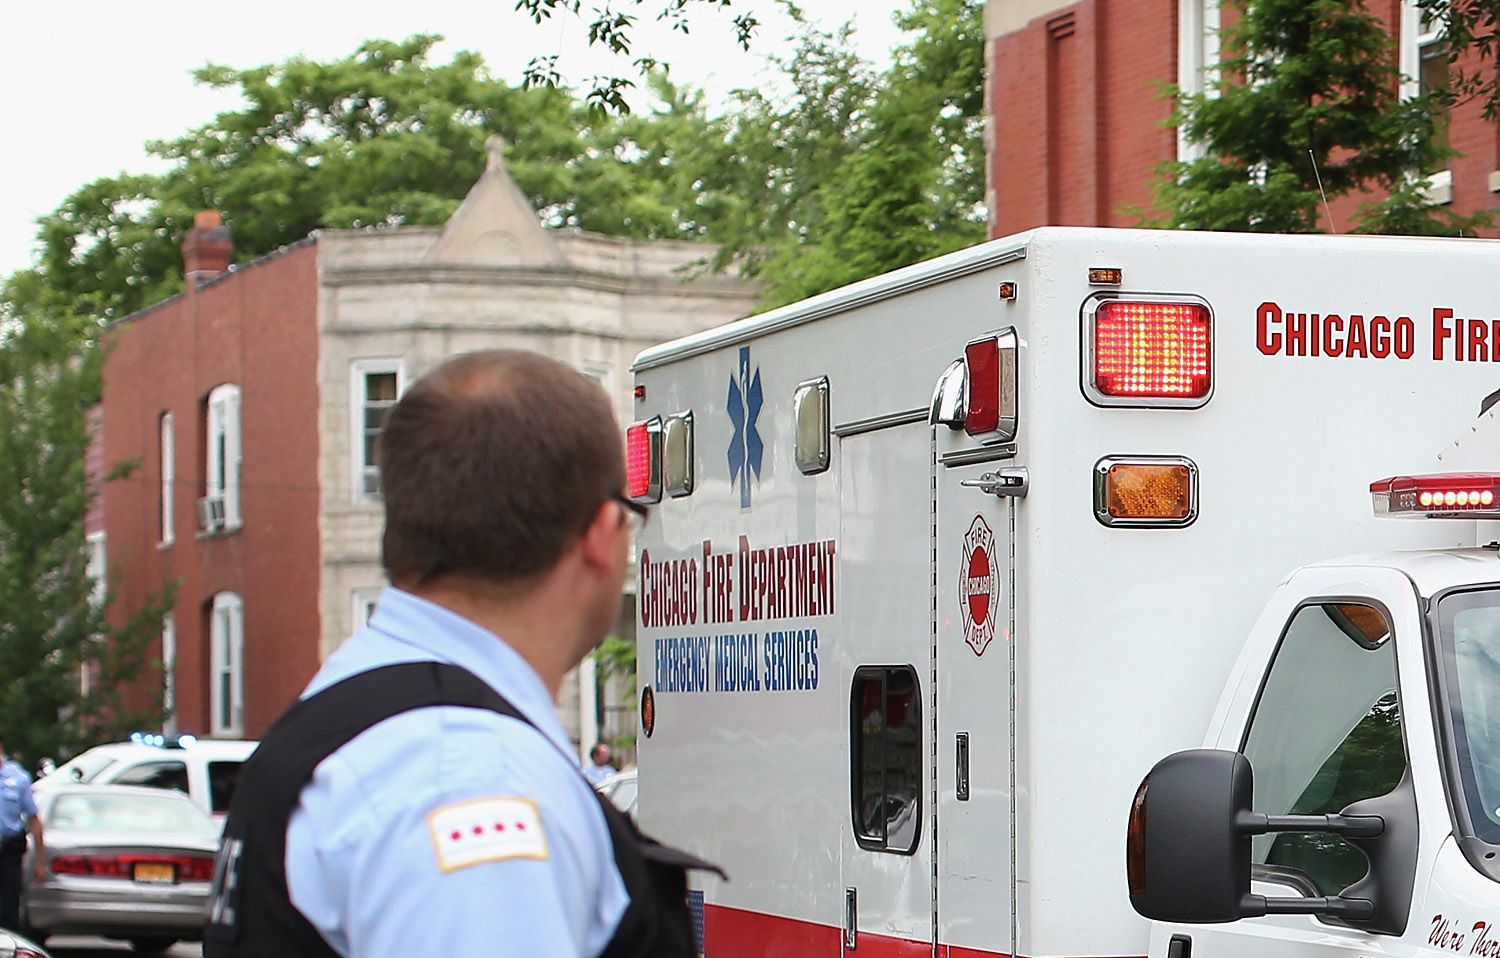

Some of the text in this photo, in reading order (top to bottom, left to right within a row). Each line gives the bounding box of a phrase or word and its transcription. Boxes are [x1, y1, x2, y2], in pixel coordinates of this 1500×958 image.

[1256, 302, 1414, 360] CHICAGO
[971, 527, 988, 548] FIRE
[641, 535, 836, 628] CHICAGO FIRE DEPARTMENT
[968, 576, 990, 595] CHICAGO
[655, 629, 818, 692] EMERGENCY MEDICAL SERVICES
[1428, 914, 1465, 951] We're
